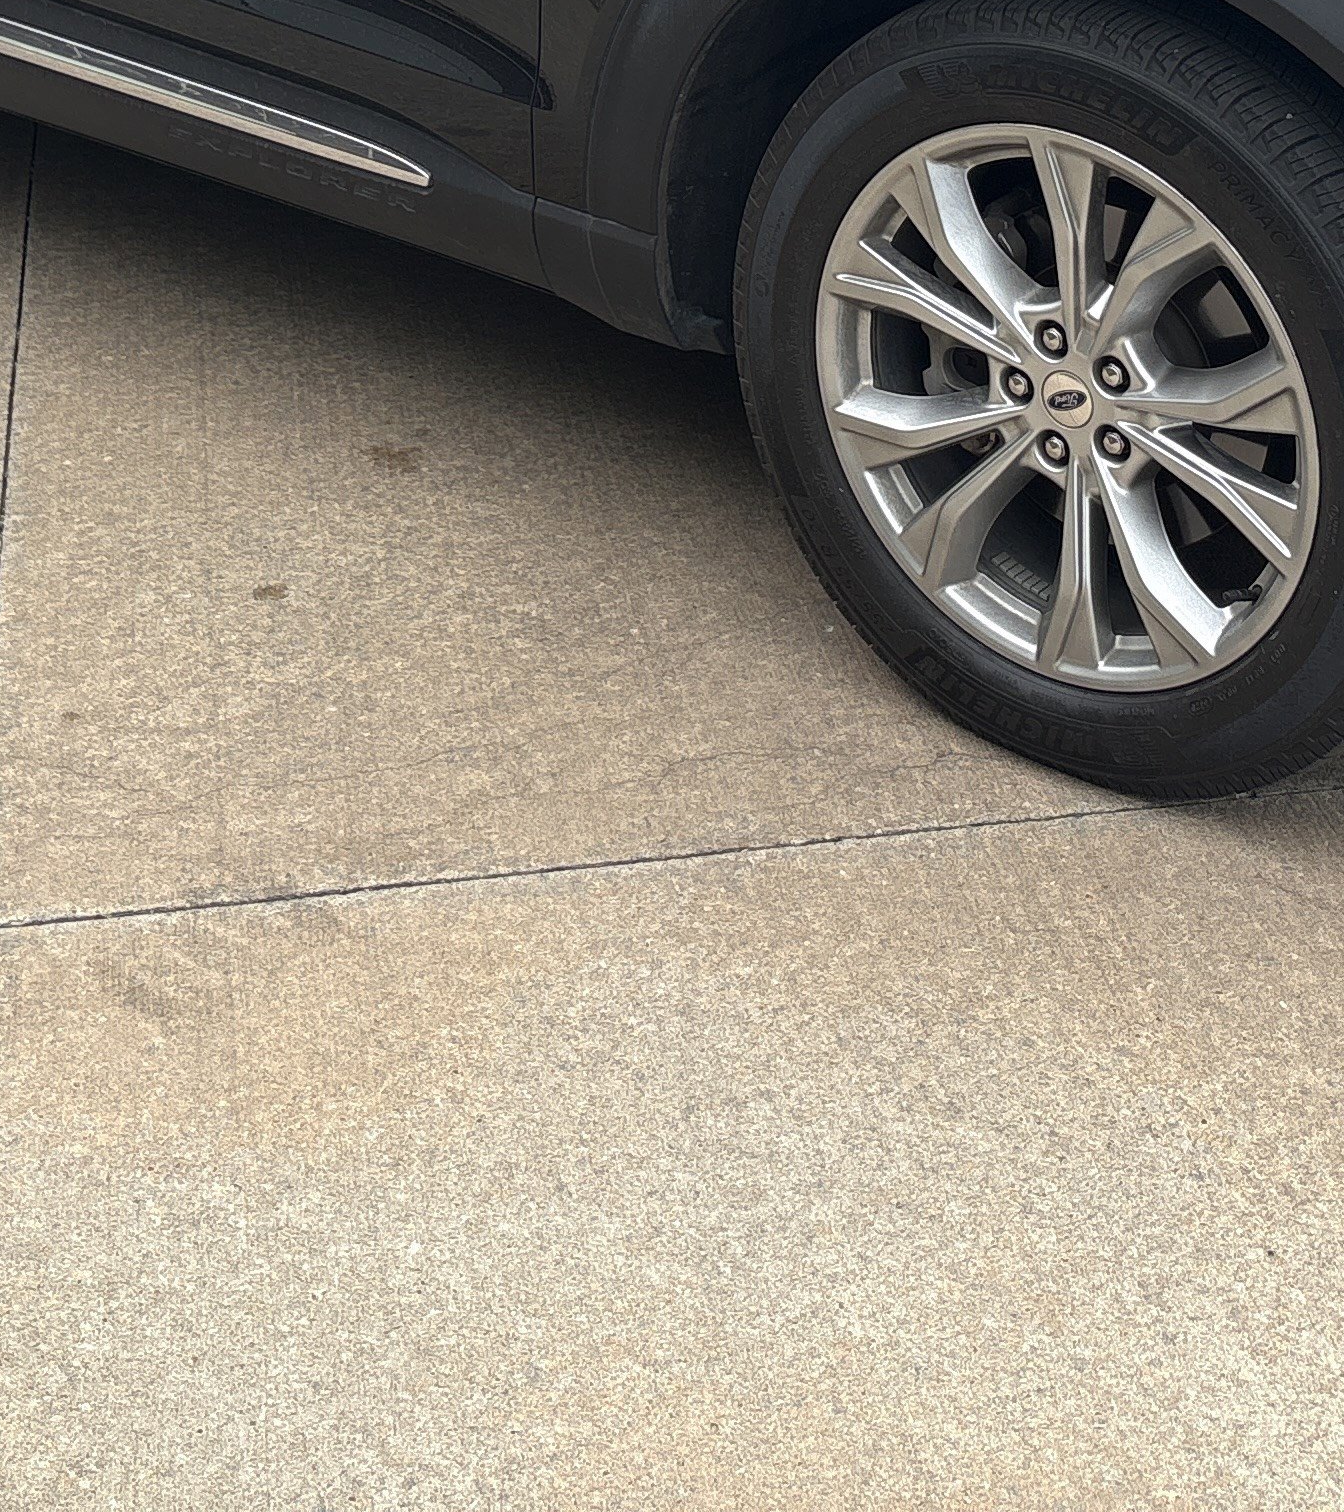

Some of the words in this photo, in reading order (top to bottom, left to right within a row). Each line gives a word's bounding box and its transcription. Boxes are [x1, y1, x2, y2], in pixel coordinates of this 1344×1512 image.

[986, 64, 1184, 149] MICHELIN
[167, 127, 417, 214] EXPLORER
[1207, 160, 1307, 262] PRIMACY
[1053, 392, 1079, 408] Ford
[914, 655, 1098, 754] MICHELIN
